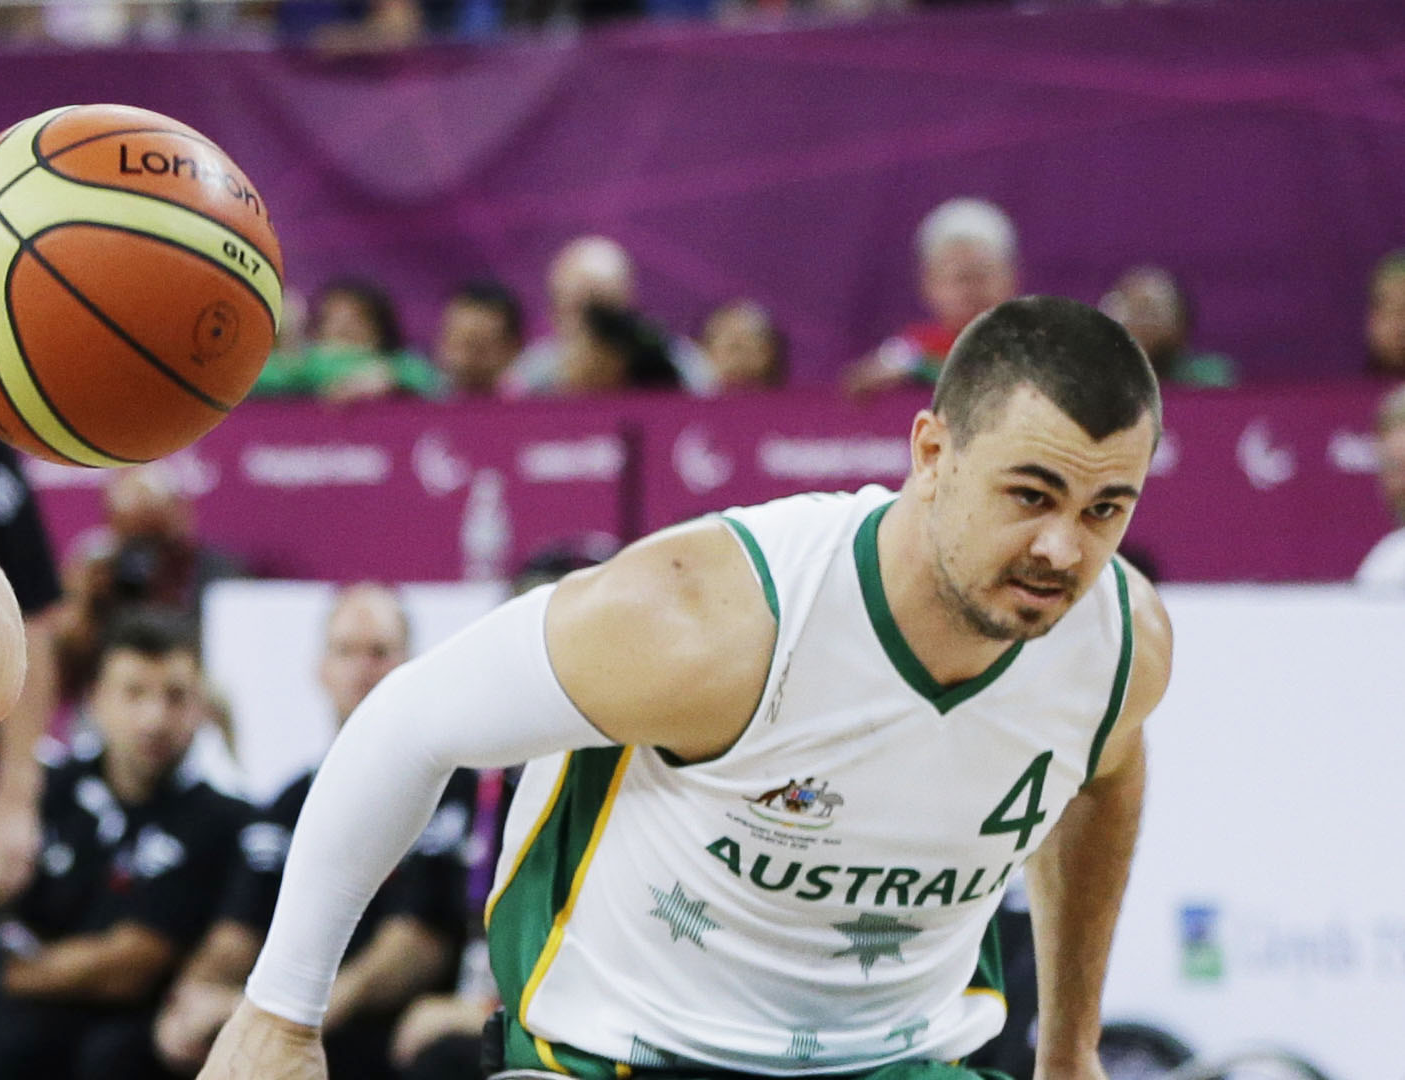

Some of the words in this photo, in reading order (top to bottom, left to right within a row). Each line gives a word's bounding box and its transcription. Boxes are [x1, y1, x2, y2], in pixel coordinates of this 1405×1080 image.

[119, 143, 260, 216] Lonon
[222, 240, 270, 275] GL7
[979, 749, 1054, 852] 4
